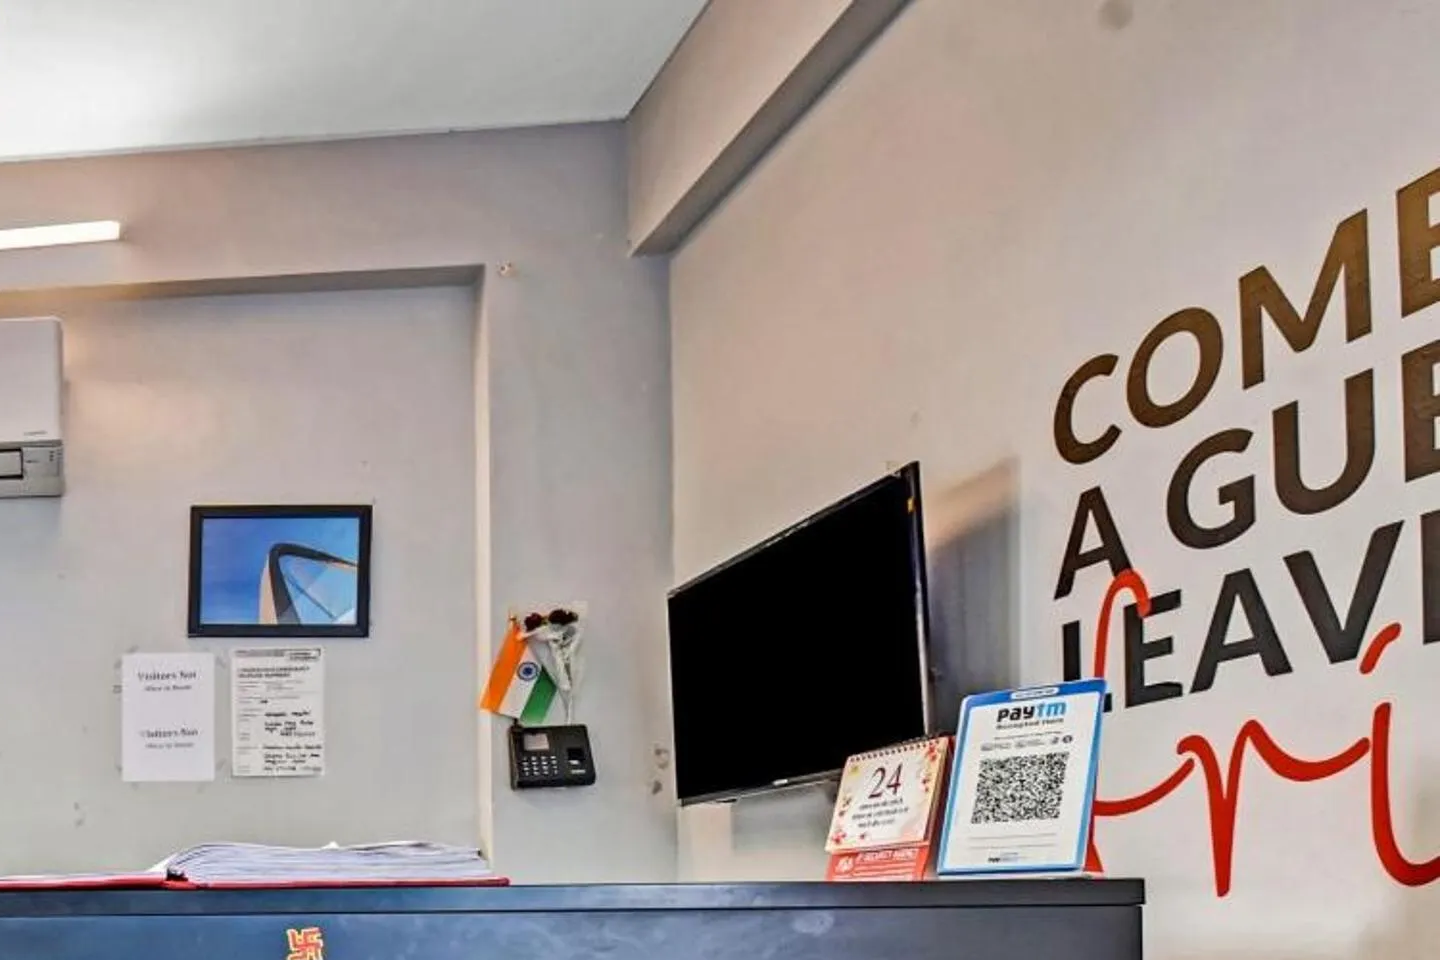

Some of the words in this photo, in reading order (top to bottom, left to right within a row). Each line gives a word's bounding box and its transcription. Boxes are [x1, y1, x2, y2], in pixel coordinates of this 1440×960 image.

[1054, 486, 1134, 600] A
[1062, 509, 1440, 712] LEAV
[868, 763, 903, 799] 24
